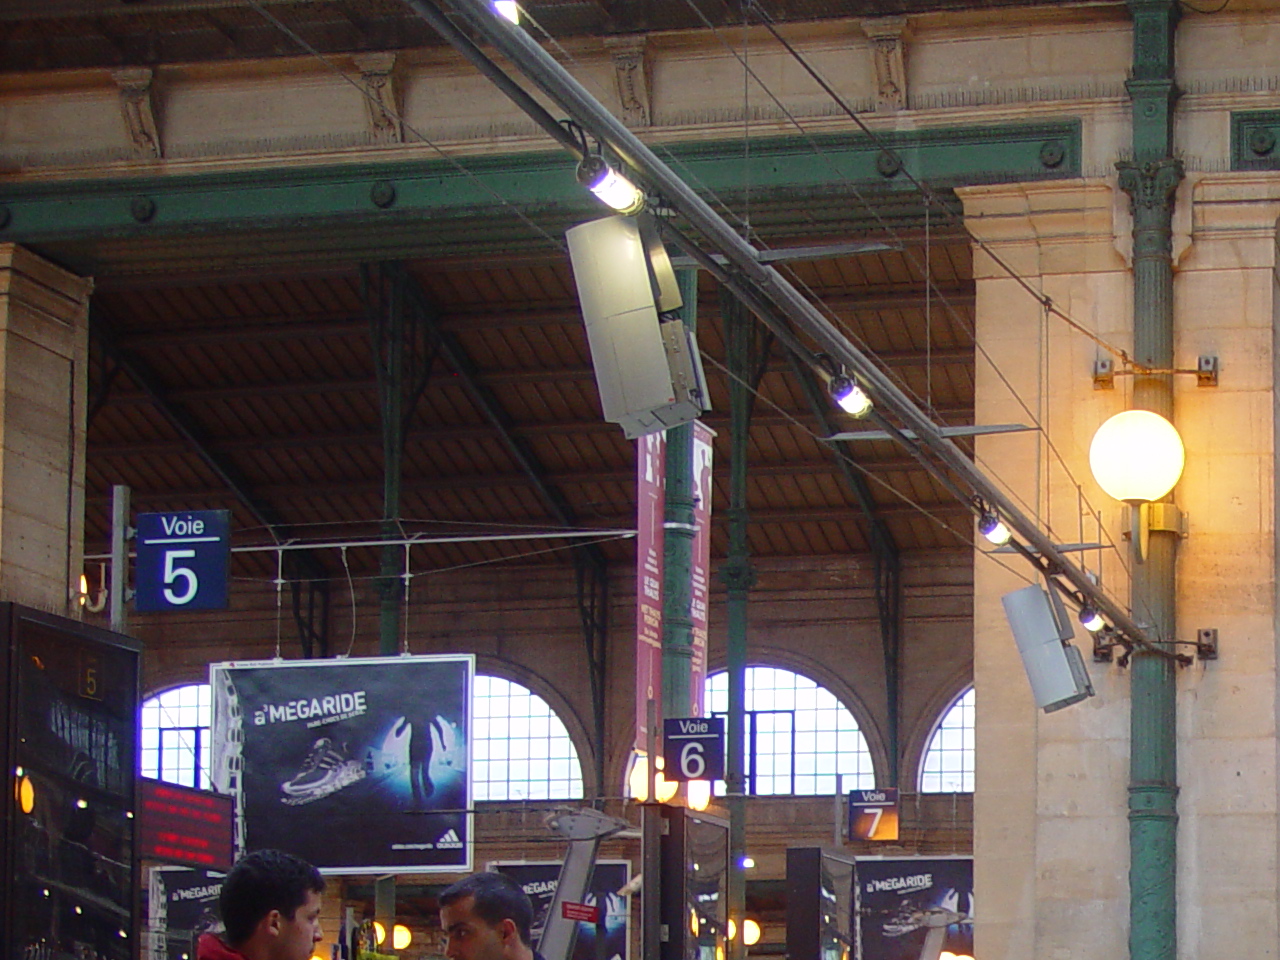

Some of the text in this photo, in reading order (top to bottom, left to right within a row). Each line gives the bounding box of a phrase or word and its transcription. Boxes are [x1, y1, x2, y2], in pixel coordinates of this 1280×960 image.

[160, 515, 205, 537] Voie
[162, 548, 198, 606] 5
[86, 668, 97, 696] 5
[680, 719, 708, 734] Voie
[680, 741, 706, 779] 6
[861, 791, 886, 802] Voie
[863, 808, 883, 838] 7
